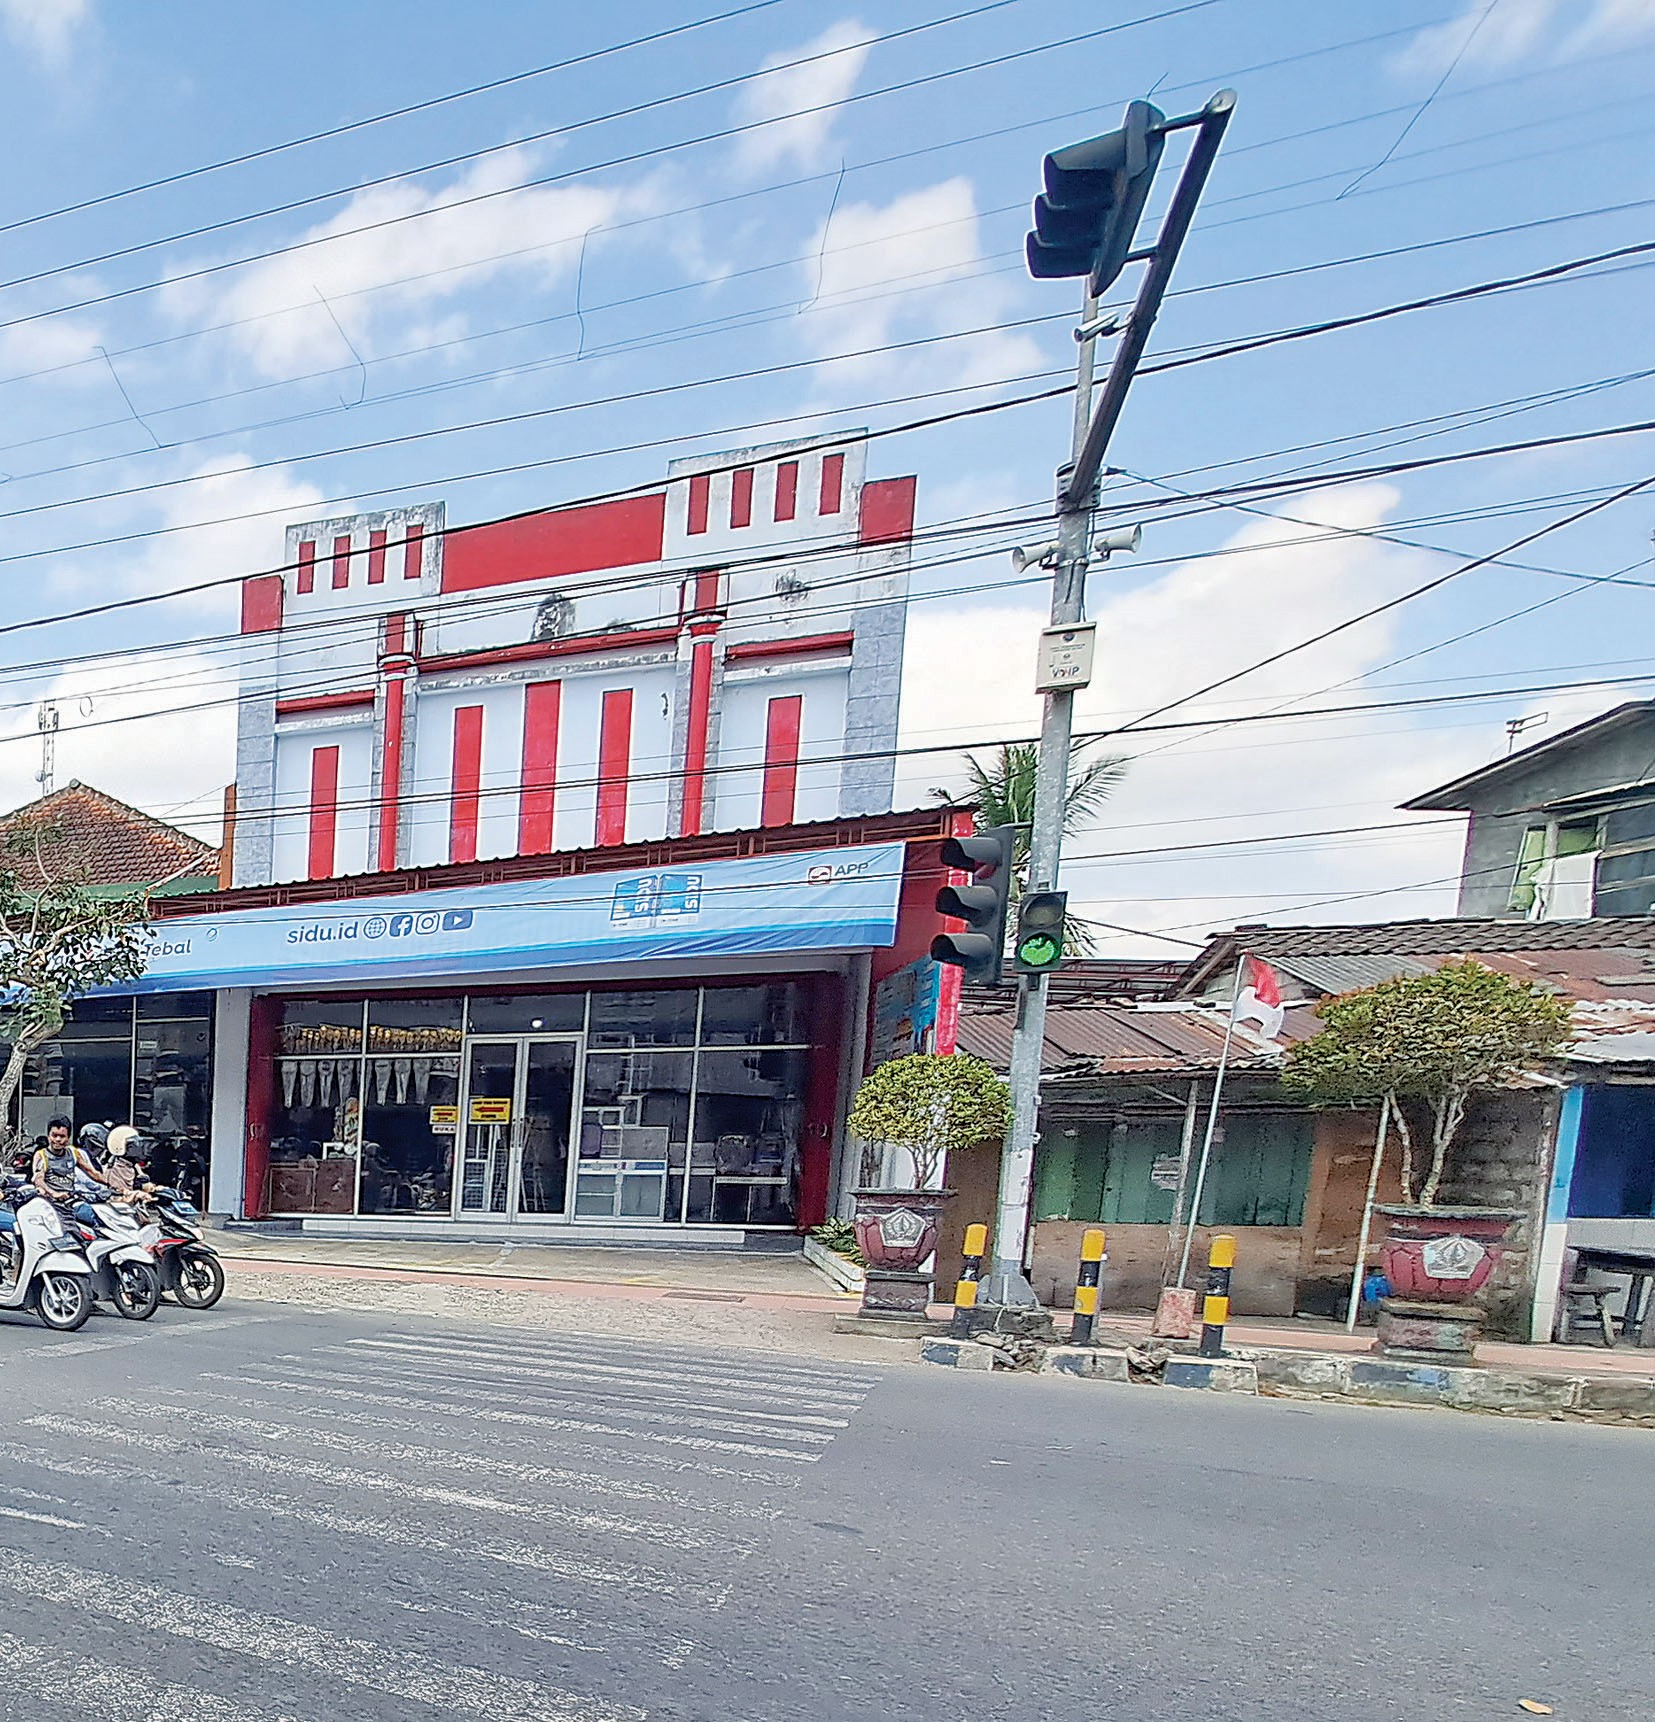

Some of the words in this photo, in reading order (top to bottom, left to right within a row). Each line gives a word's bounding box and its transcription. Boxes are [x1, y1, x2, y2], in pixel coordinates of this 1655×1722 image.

[835, 862, 869, 876] APP
[287, 921, 358, 944] sidu.id
[144, 938, 191, 957] Tebal
